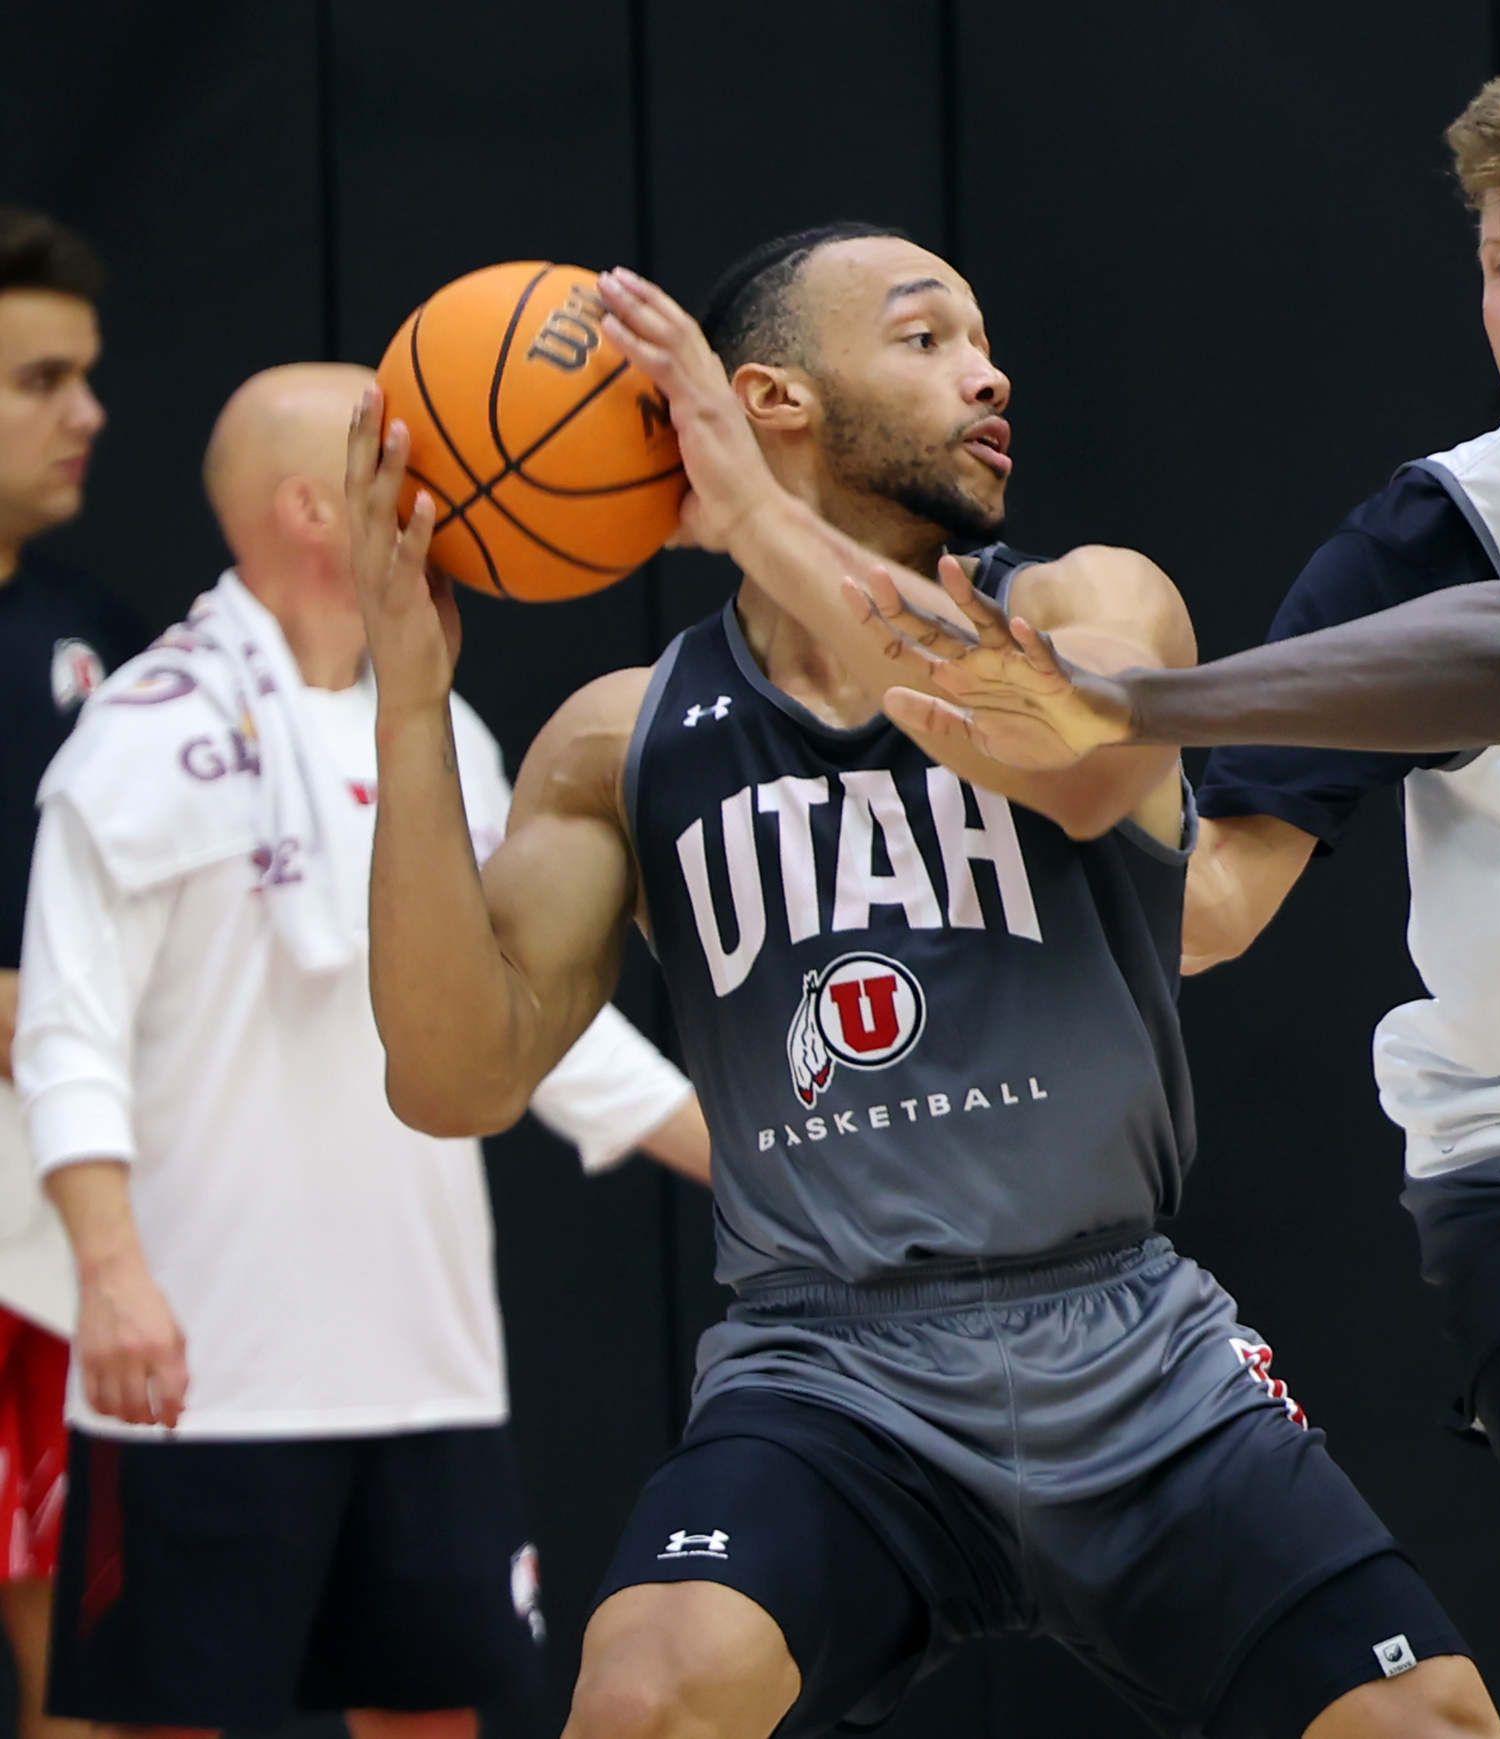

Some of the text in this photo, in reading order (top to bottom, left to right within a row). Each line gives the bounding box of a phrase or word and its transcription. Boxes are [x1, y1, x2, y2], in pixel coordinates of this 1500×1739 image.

[527, 284, 608, 371] Wil
[676, 765, 1043, 998] UTAH
[830, 974, 899, 1053] U
[758, 1076, 1048, 1151] BASKETBALL
